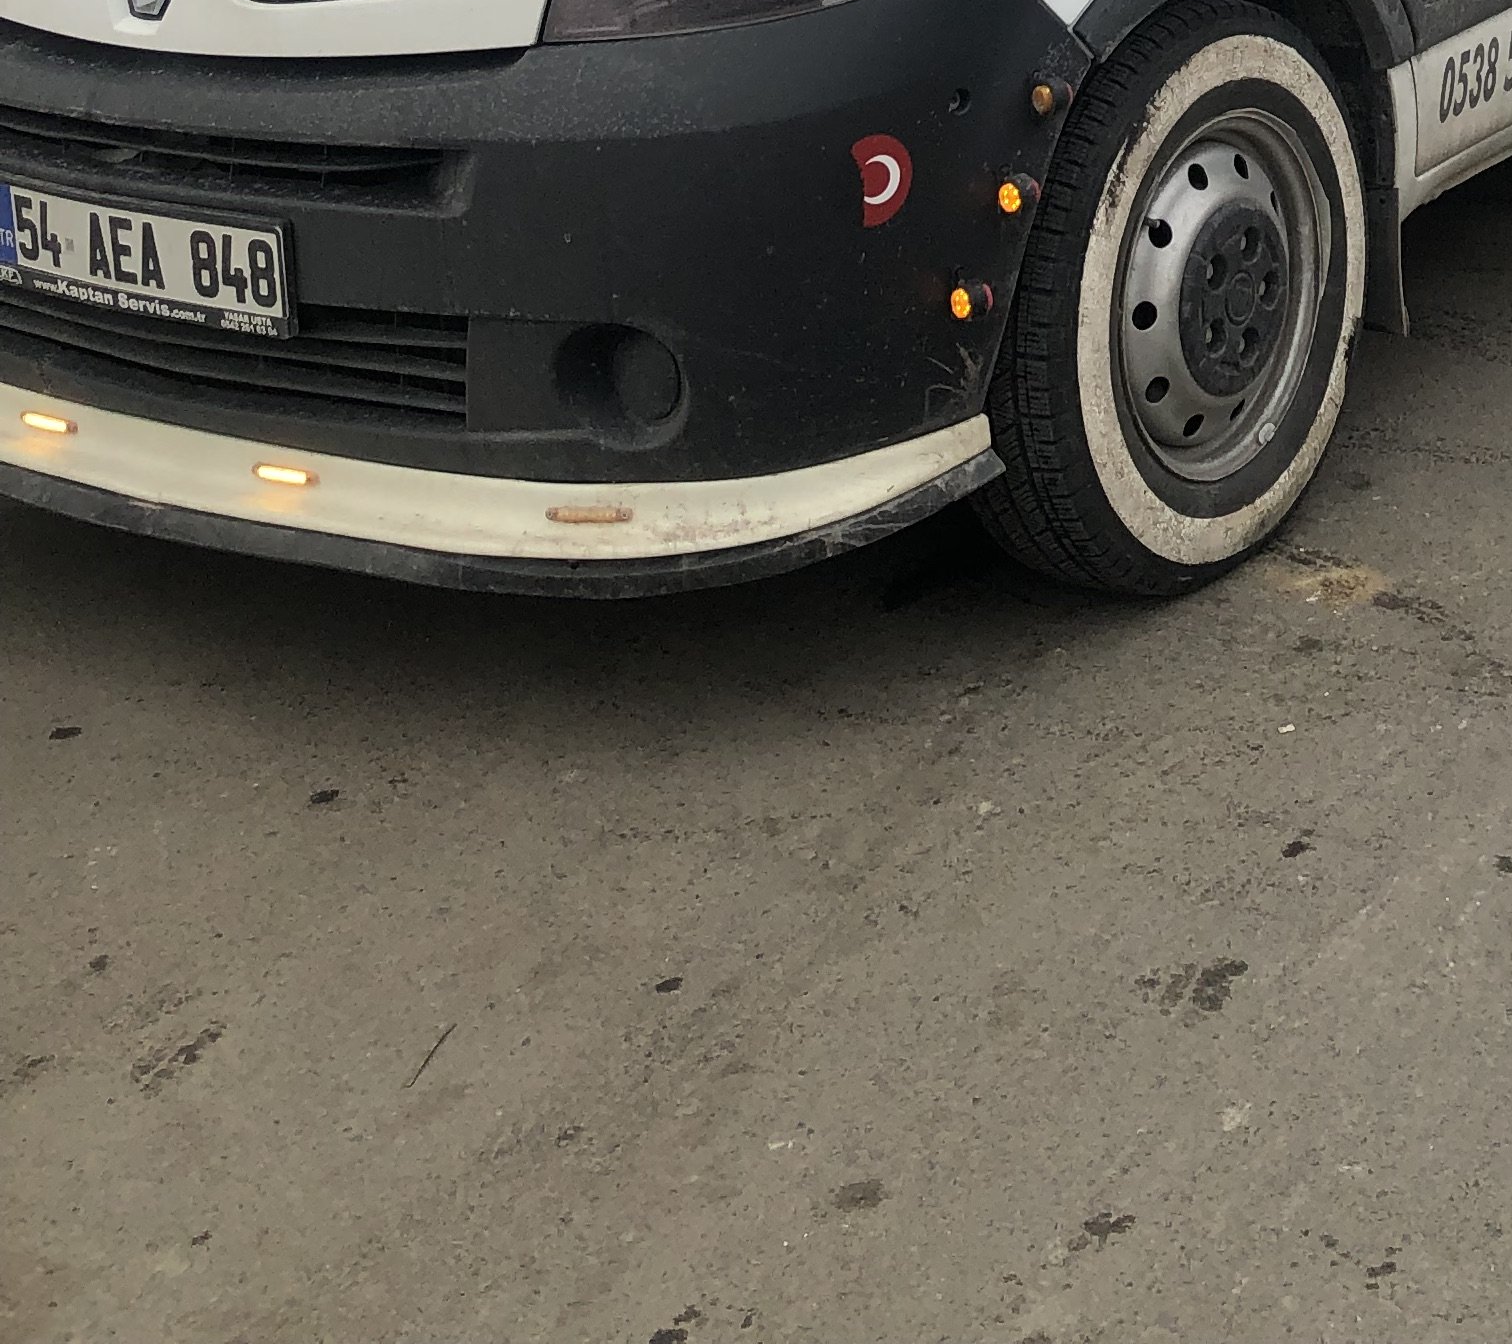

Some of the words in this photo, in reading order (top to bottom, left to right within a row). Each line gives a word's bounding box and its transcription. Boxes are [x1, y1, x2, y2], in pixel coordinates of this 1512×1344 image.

[1439, 37, 1499, 123] 0538
[0, 228, 14, 248] TR
[14, 194, 62, 268] 54
[89, 212, 166, 290] AEA
[190, 230, 278, 308] 848
